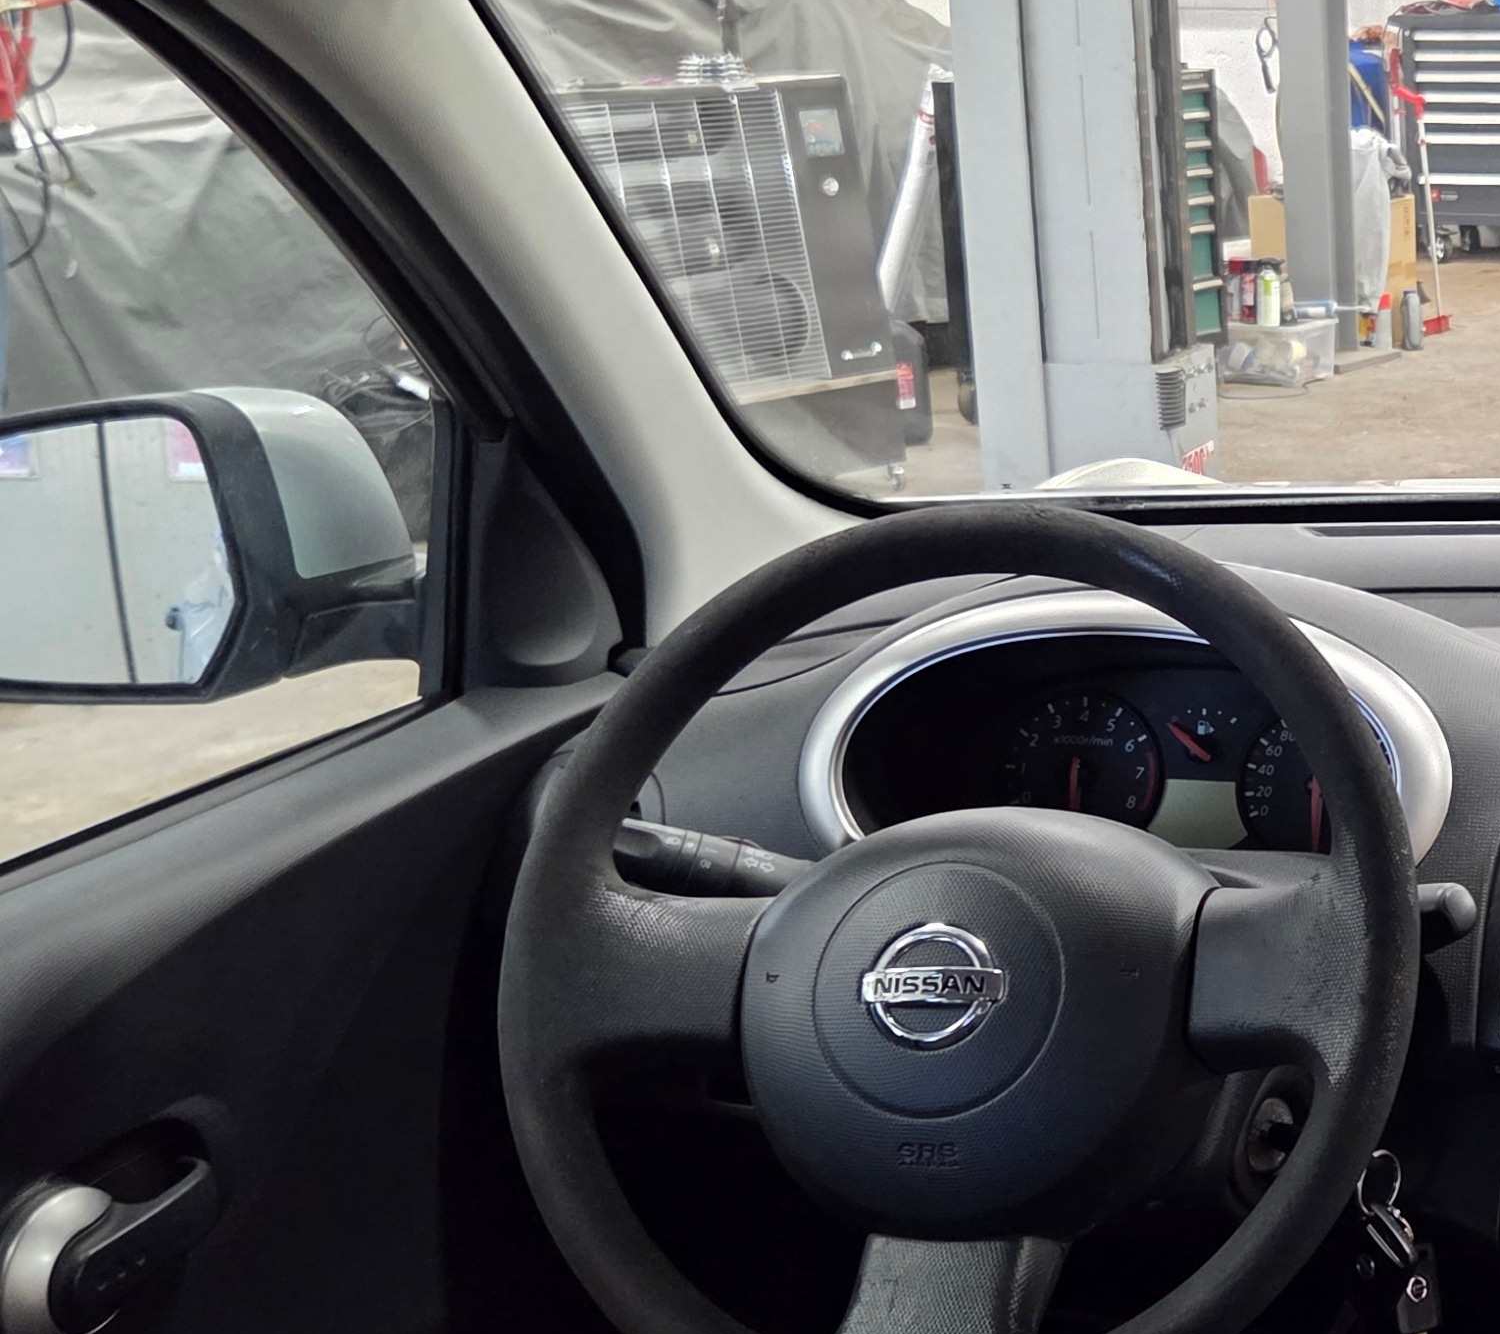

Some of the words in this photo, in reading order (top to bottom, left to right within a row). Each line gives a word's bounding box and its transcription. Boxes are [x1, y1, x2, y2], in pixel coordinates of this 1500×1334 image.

[1052, 714, 1063, 729] 3
[1079, 710, 1090, 722] 4
[1105, 718, 1117, 733] 5
[1029, 733, 1039, 747] 2
[1124, 739, 1135, 753] 6
[1265, 745, 1283, 758] 60
[1135, 766, 1145, 780] 7
[1257, 764, 1275, 776] 40
[1255, 785, 1273, 798] 20
[1125, 795, 1137, 809] 8
[1259, 805, 1269, 817] 0
[873, 975, 985, 996] NISSAN
